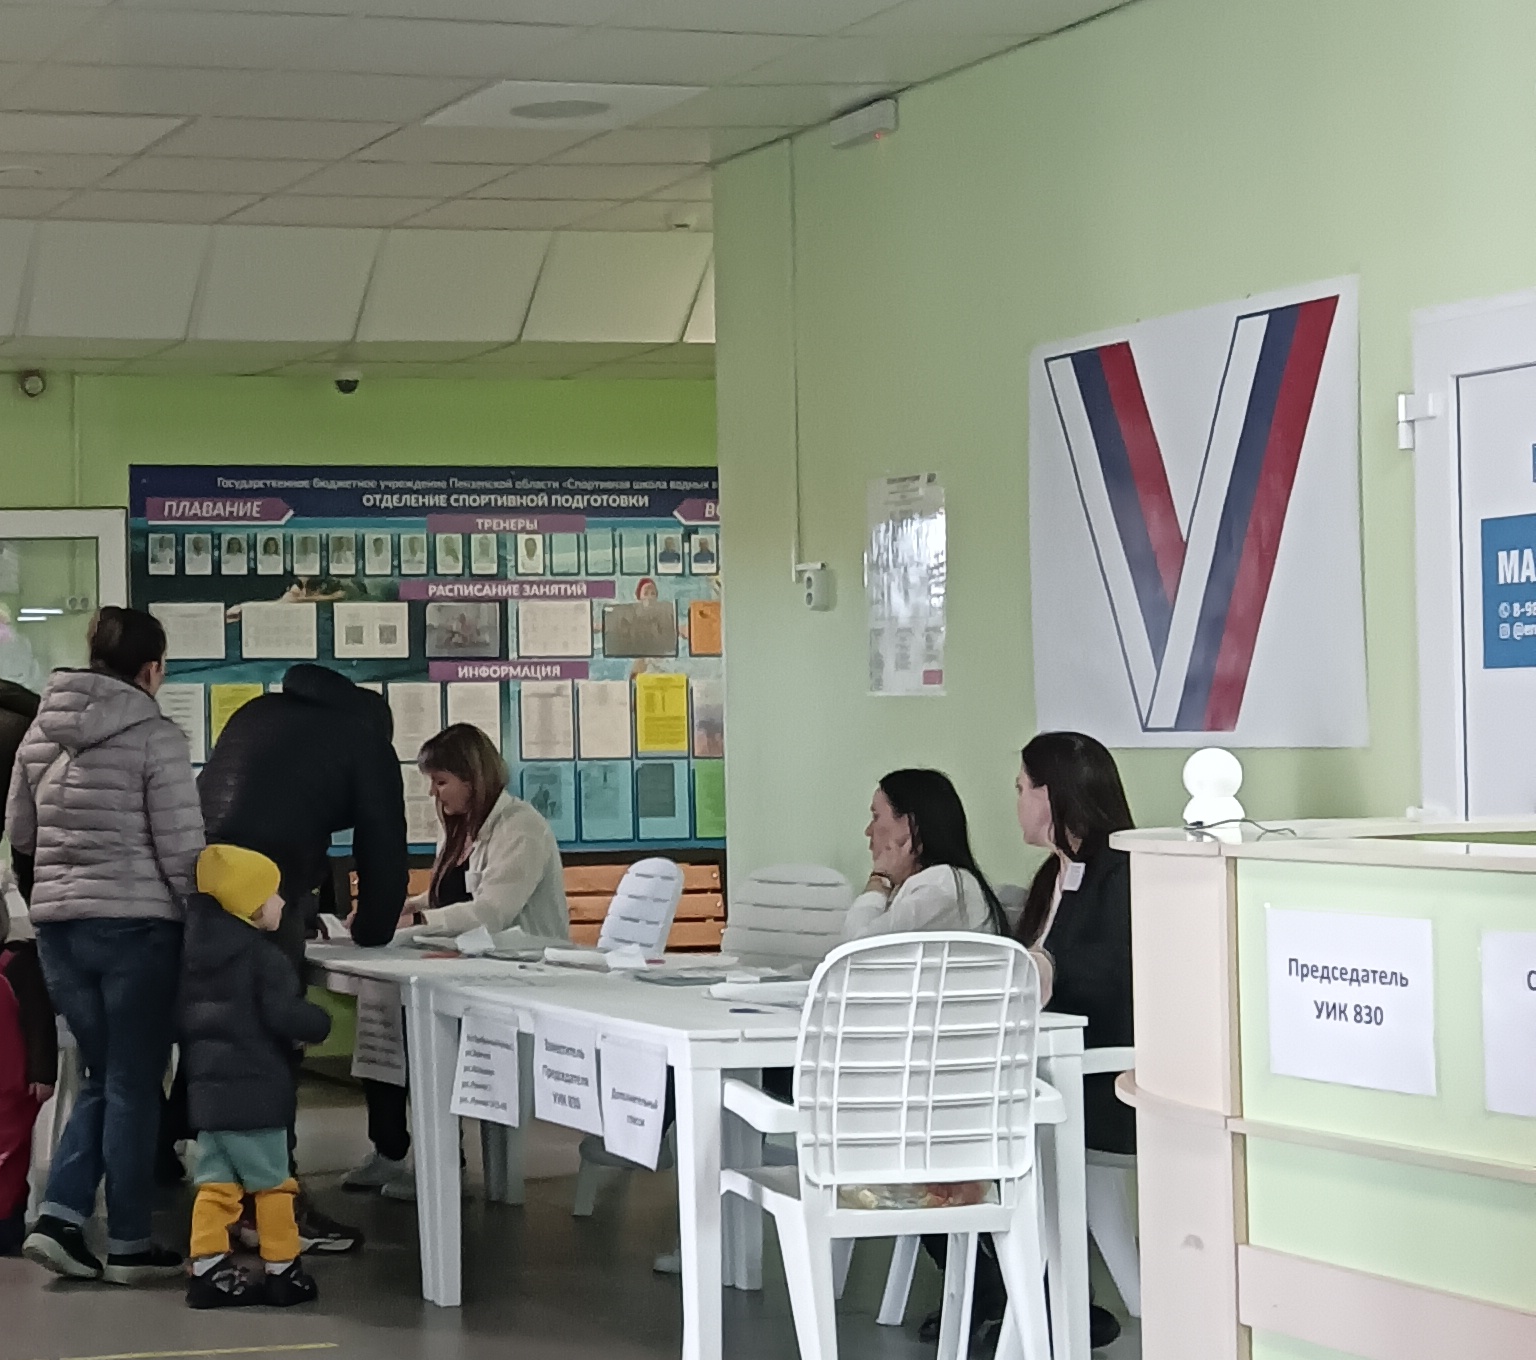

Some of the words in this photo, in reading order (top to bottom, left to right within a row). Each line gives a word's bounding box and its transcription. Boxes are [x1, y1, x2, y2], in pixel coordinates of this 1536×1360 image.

[163, 500, 262, 518] ПЛАВАНИЕ
[363, 493, 447, 508] ОТДЕЛЕНИЕ
[450, 493, 549, 508] СПОРТИВНОЙ
[552, 494, 649, 509] ПОДГОТОВКИ
[476, 517, 538, 531] ТРЕНЕРЫ
[427, 583, 519, 598] РАСПИСАНИЕ
[522, 582, 587, 597] ЗАНЯТИЙ
[458, 664, 561, 680] ИНФОРМАЦИЯ
[1288, 957, 1409, 987] Председатель
[1313, 999, 1349, 1022] УИК
[1353, 1004, 1384, 1026] 830
